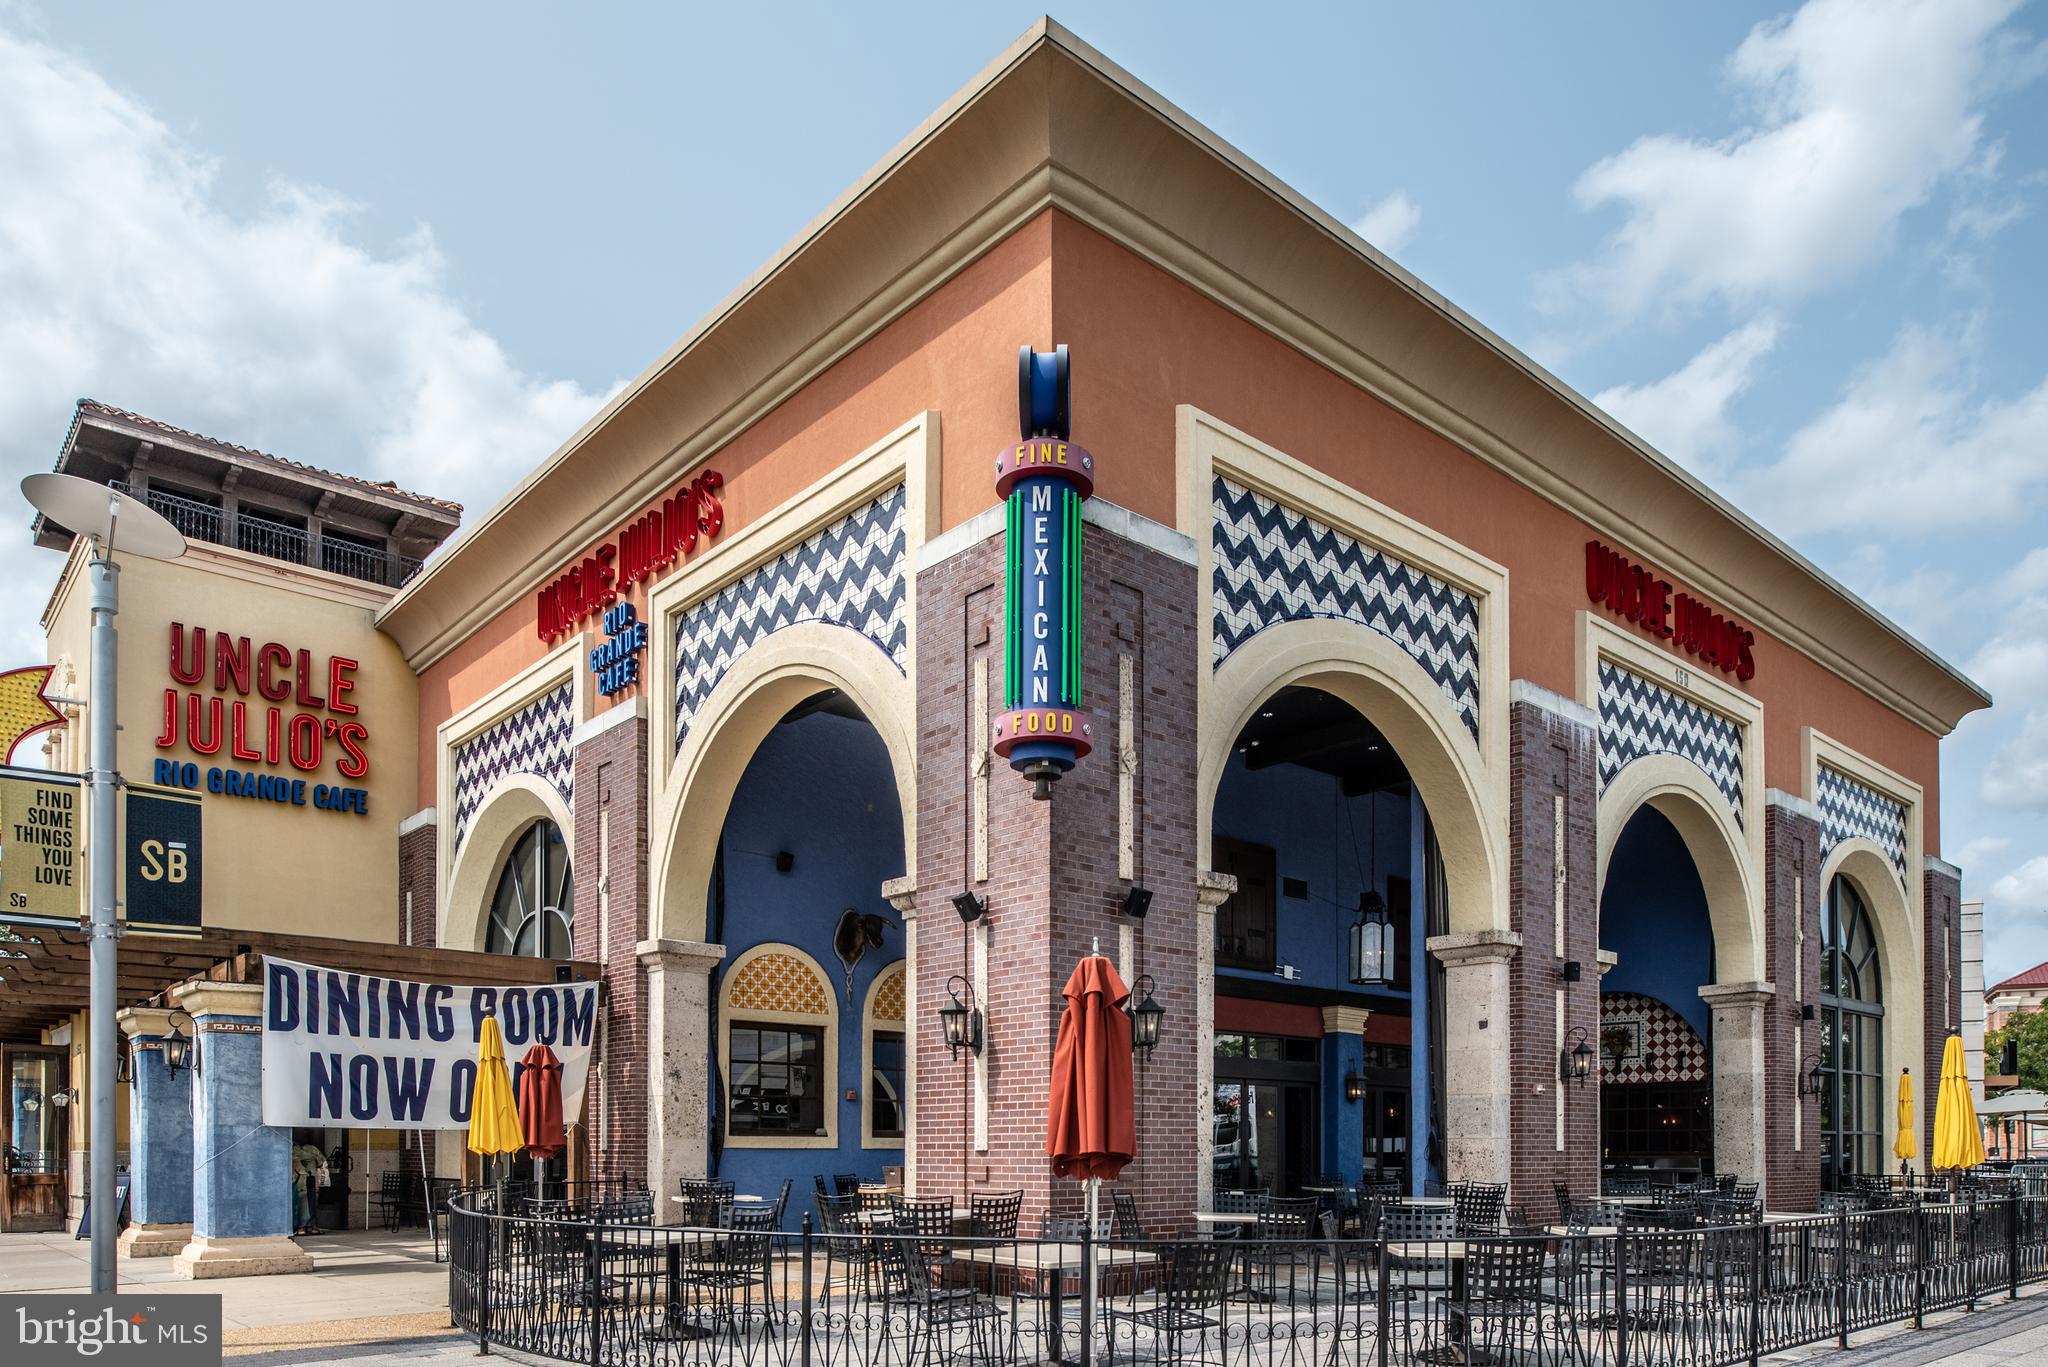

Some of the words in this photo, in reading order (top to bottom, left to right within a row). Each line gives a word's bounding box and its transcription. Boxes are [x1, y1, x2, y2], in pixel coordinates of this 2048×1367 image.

[1015, 444, 1067, 467] FINE
[1032, 485, 1051, 703] MEXICAN
[604, 601, 637, 636] RIO
[590, 622, 648, 673] GRANDE
[169, 621, 359, 715] UNCLE
[598, 657, 639, 697] CAFE
[155, 688, 369, 778] JULIO'S
[1012, 712, 1073, 734] FOOD
[36, 789, 73, 809] FIND
[154, 758, 199, 789] RIO
[207, 767, 305, 806] GRANDE
[314, 783, 369, 815] CAFE
[14, 825, 73, 848] THINGS
[28, 807, 73, 829] SOME
[42, 847, 73, 867] YOU
[35, 866, 72, 886] LOVE
[268, 963, 455, 1042] DINING
[470, 987, 595, 1046] ROOM
[309, 1052, 435, 1121] NOW
